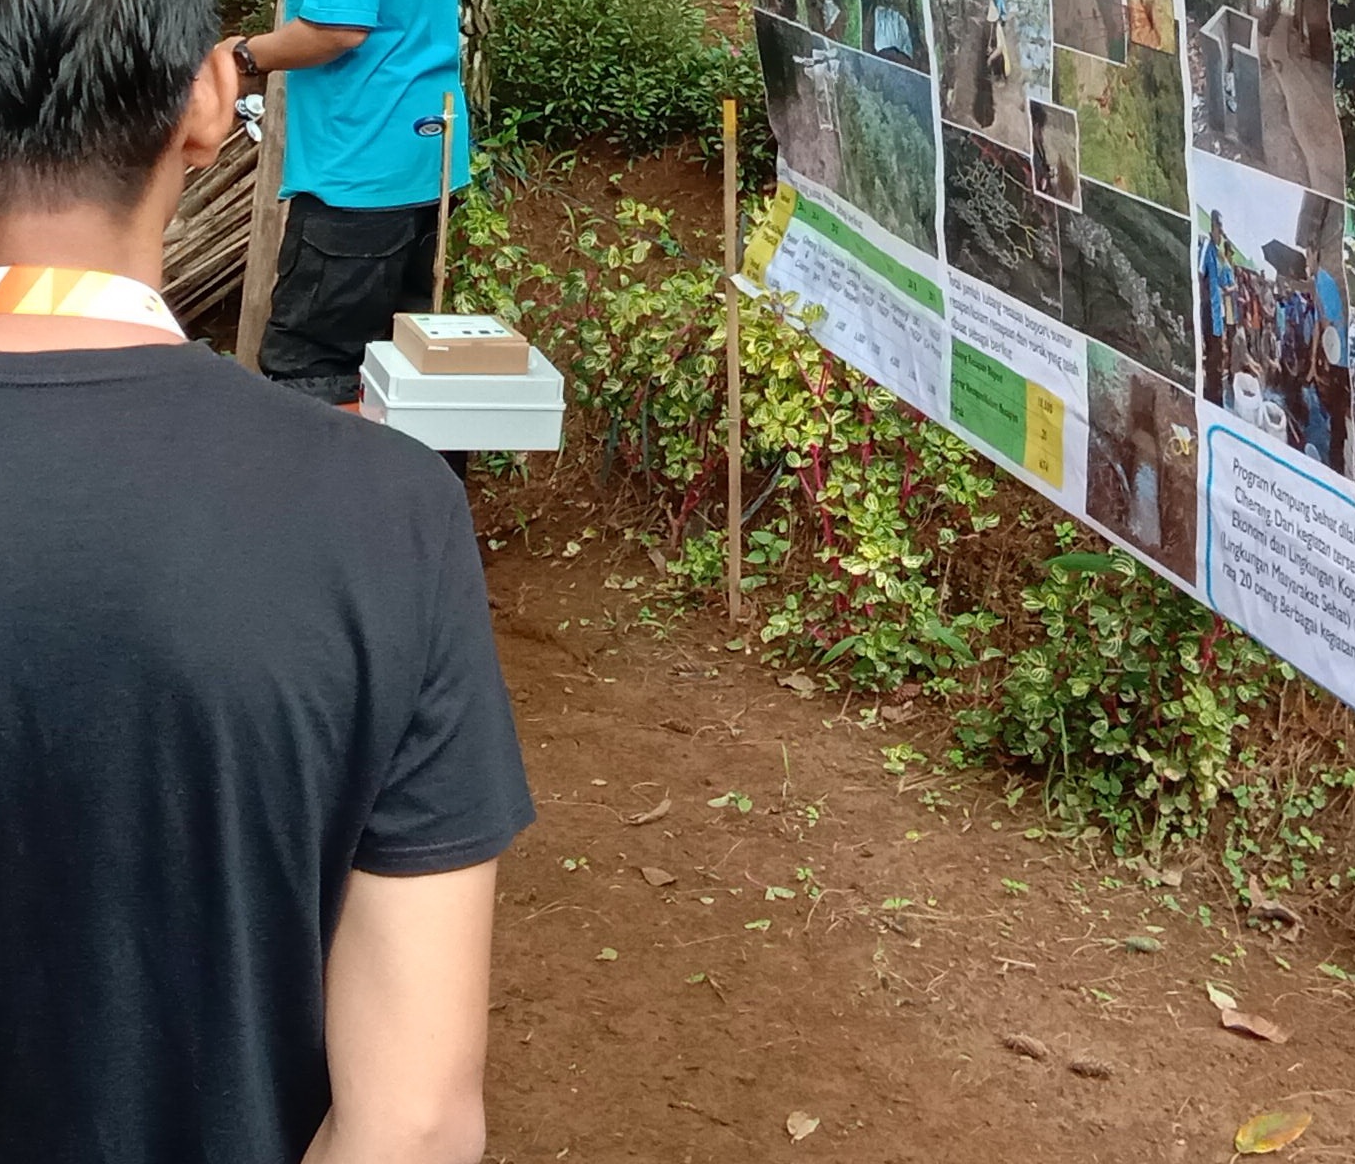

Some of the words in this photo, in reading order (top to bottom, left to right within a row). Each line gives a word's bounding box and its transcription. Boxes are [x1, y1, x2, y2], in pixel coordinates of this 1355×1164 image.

[1233, 457, 1269, 493] Program
[1271, 482, 1311, 523] Kampung
[1312, 504, 1338, 533] Sehat
[1232, 510, 1268, 547] Ekonomi
[1270, 536, 1286, 558] dan
[1296, 523, 1331, 558] kegiatan
[1239, 568, 1253, 591] 20
[1279, 595, 1318, 635] Berbagai
